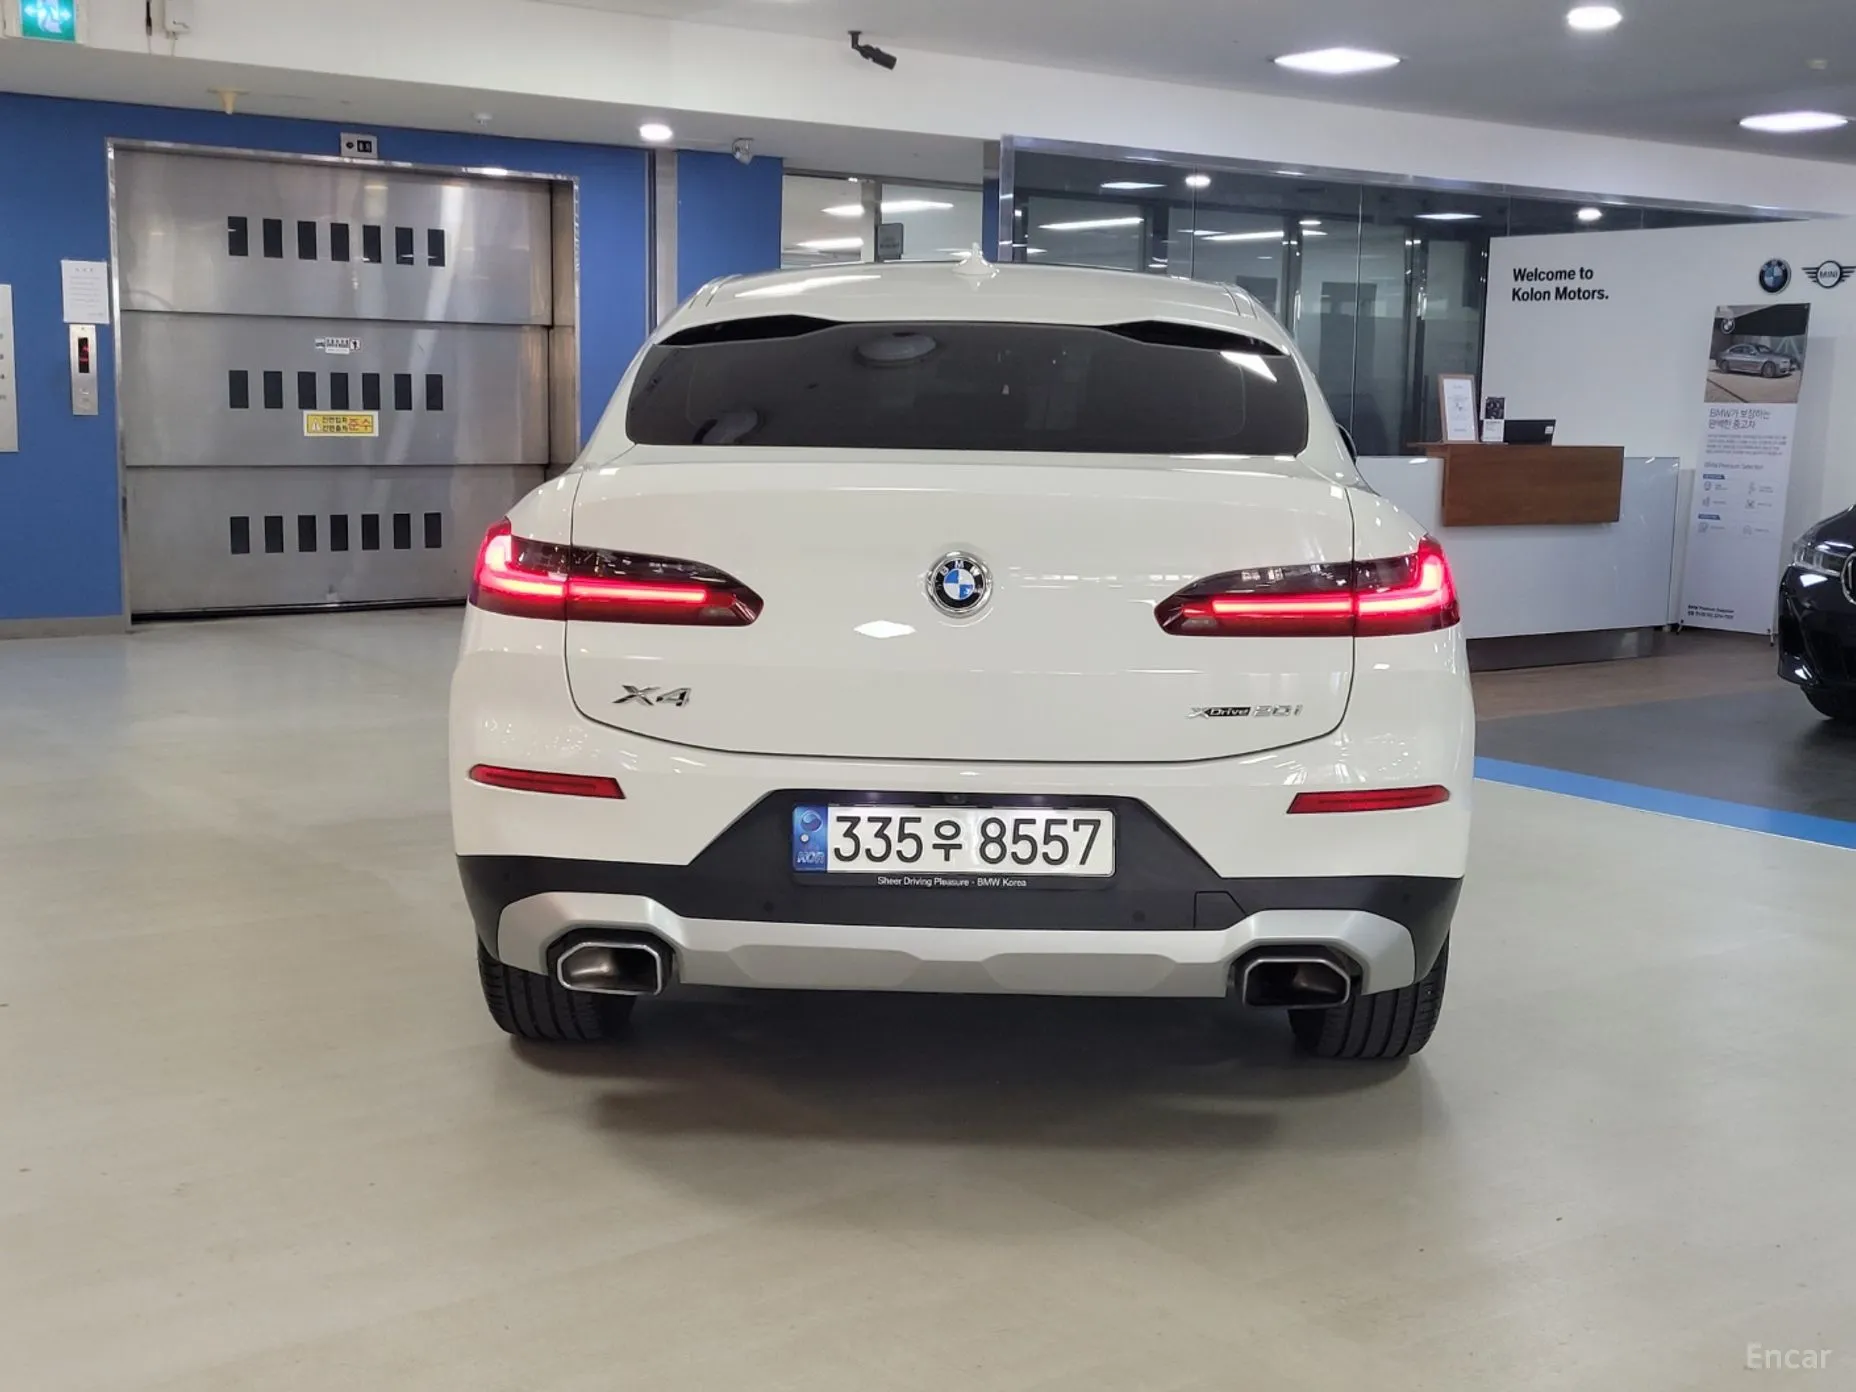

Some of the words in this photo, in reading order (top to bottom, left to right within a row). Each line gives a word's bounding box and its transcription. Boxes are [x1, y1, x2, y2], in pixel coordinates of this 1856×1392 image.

[1513, 267, 1576, 282] Welcome
[1579, 266, 1594, 280] to
[1819, 270, 1839, 279] MINI
[1511, 287, 1551, 302] Kolon
[1554, 286, 1609, 301] Motors.
[612, 684, 692, 707] X4
[833, 815, 963, 864] 335우
[978, 816, 1101, 866] 8557
[877, 876, 902, 886] Sheer
[903, 877, 932, 888] Driving
[934, 877, 970, 887] Pleasure
[977, 878, 1000, 887] BMW
[1002, 878, 1027, 887] Korea
